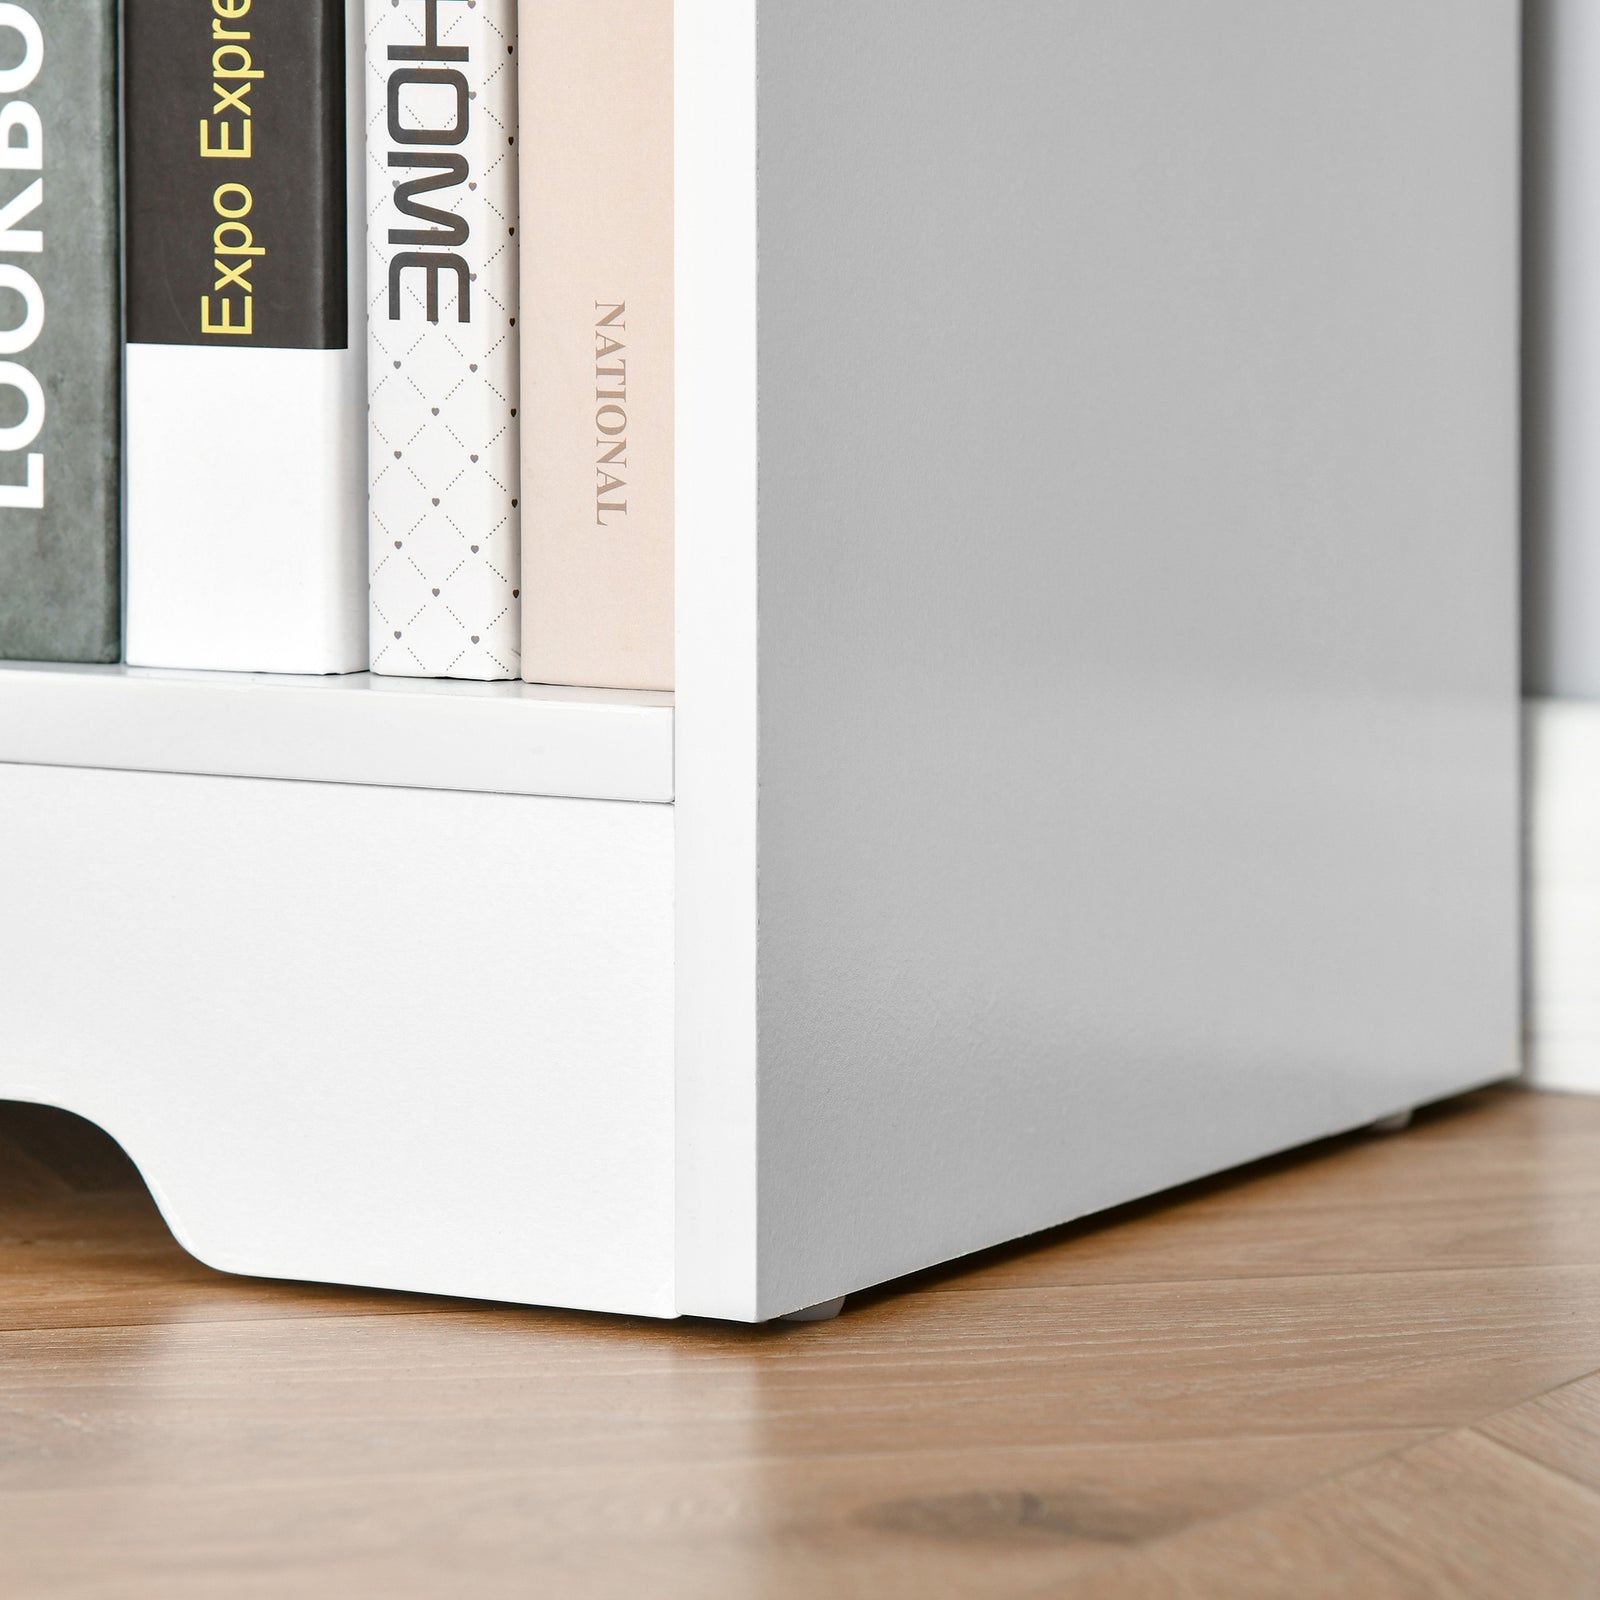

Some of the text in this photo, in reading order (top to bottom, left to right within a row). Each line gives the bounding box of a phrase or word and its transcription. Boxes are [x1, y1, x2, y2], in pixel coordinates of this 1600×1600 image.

[200, 182, 267, 336] Expo
[386, 0, 471, 324] HOME
[594, 300, 628, 527] NATIONAL
